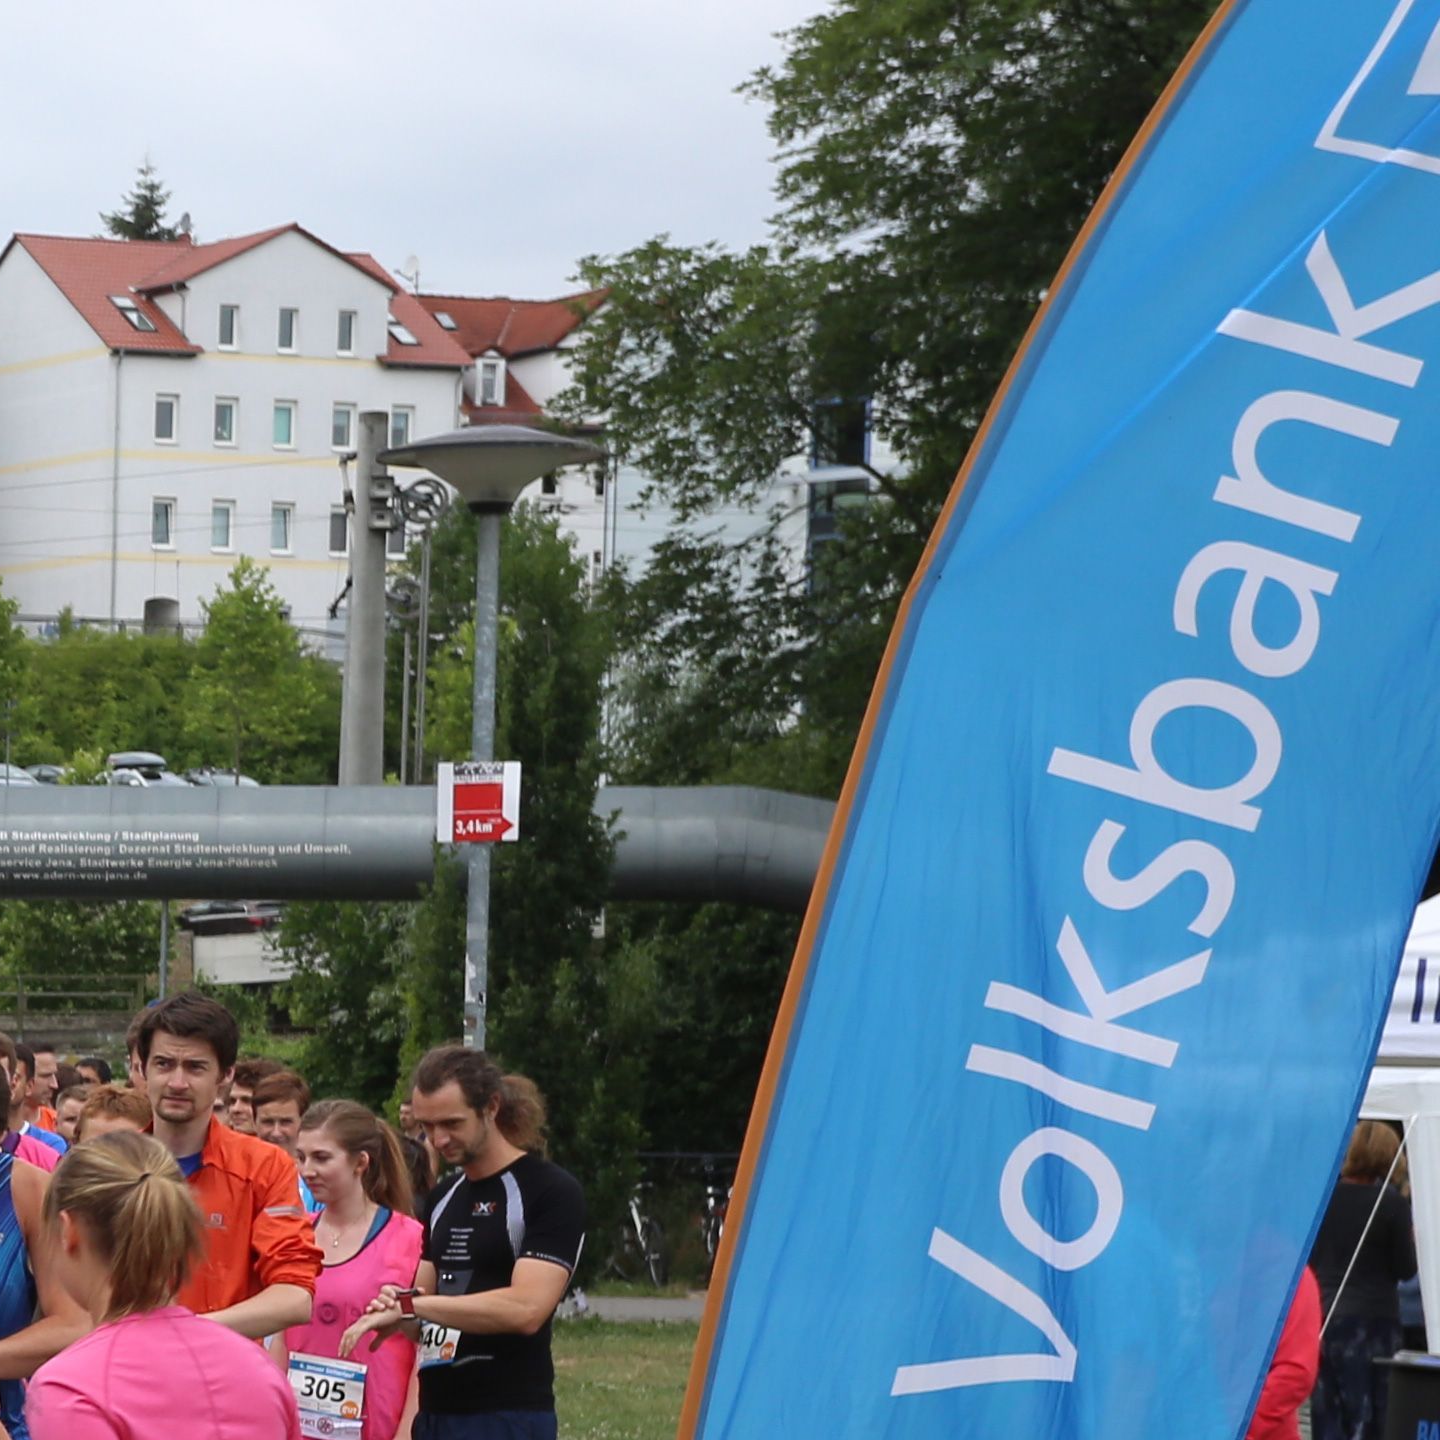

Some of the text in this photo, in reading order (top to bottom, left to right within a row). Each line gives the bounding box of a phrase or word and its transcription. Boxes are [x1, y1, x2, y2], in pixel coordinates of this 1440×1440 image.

[890, 228, 1440, 1397] Volksbank
[11, 830, 112, 843] Stadtentwicklung
[121, 831, 200, 843] Stadtplanung
[15, 843, 34, 854] und
[173, 843, 275, 855] Stadtentwicklung
[278, 843, 301, 855] und
[300, 1375, 346, 1402] 305
